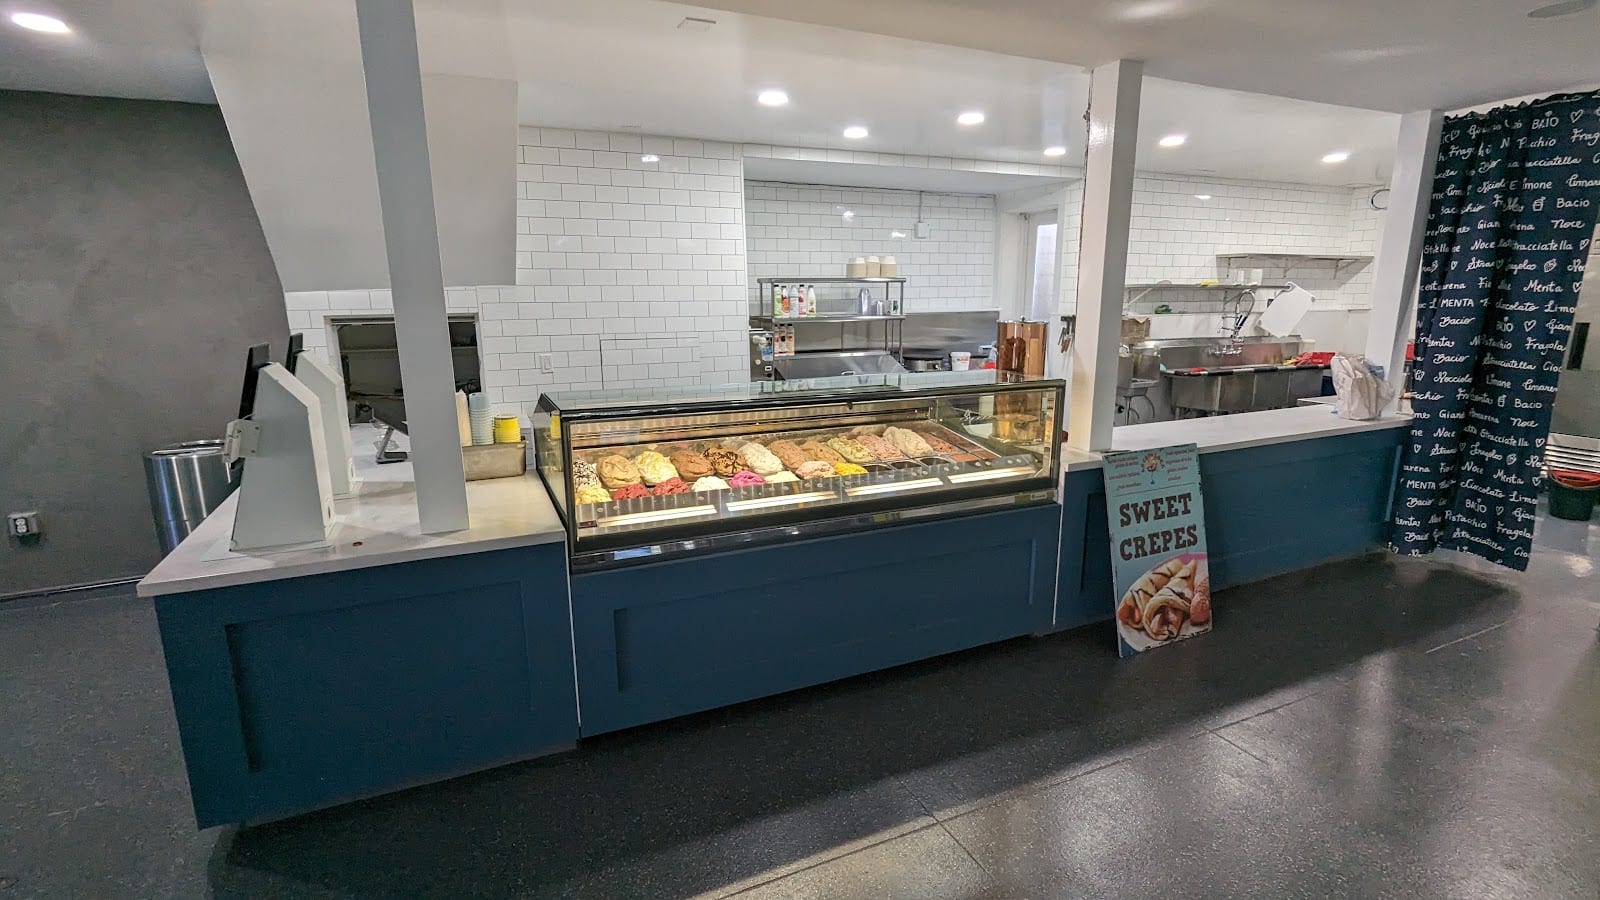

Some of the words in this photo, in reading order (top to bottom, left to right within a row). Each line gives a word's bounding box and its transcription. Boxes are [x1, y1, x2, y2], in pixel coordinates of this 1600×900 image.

[1556, 197, 1590, 209] Bacio
[1522, 279, 1564, 293] Menta
[1440, 298, 1475, 308] MENTA
[1514, 398, 1543, 409] Bacio
[1405, 479, 1436, 490] MENTA
[1119, 492, 1192, 527] SWEET
[1119, 523, 1198, 561] CREPES
